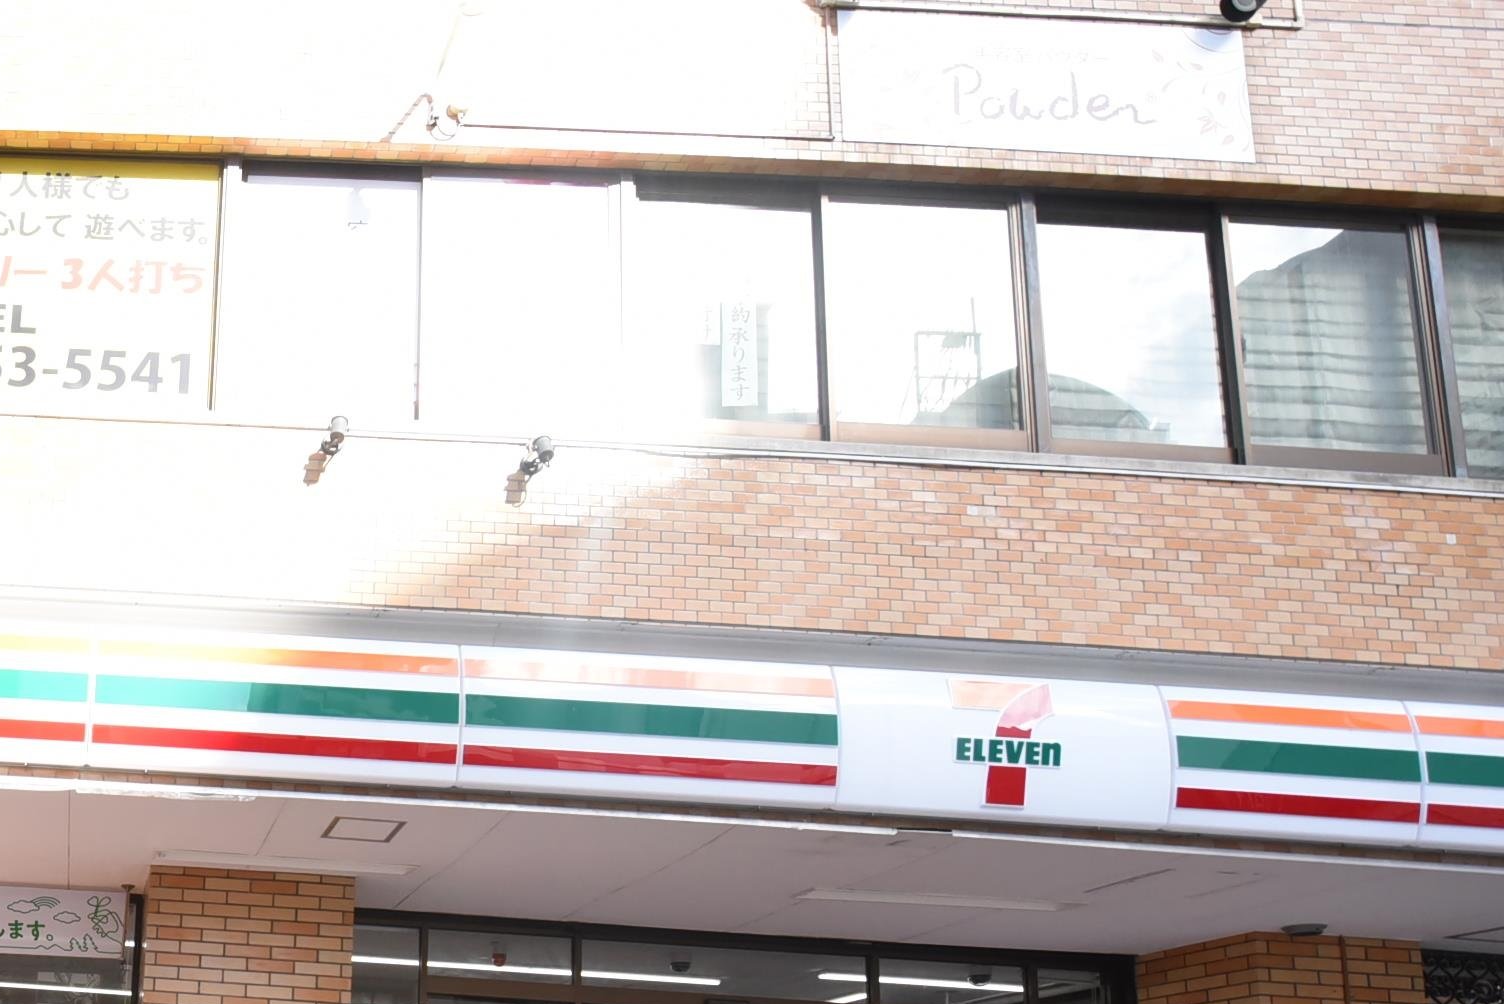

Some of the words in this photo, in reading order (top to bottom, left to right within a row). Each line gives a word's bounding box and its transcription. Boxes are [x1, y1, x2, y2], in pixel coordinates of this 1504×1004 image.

[942, 63, 1159, 125] Powder
[83, 212, 209, 245] 遊べます。
[62, 257, 204, 295] 3人打ち
